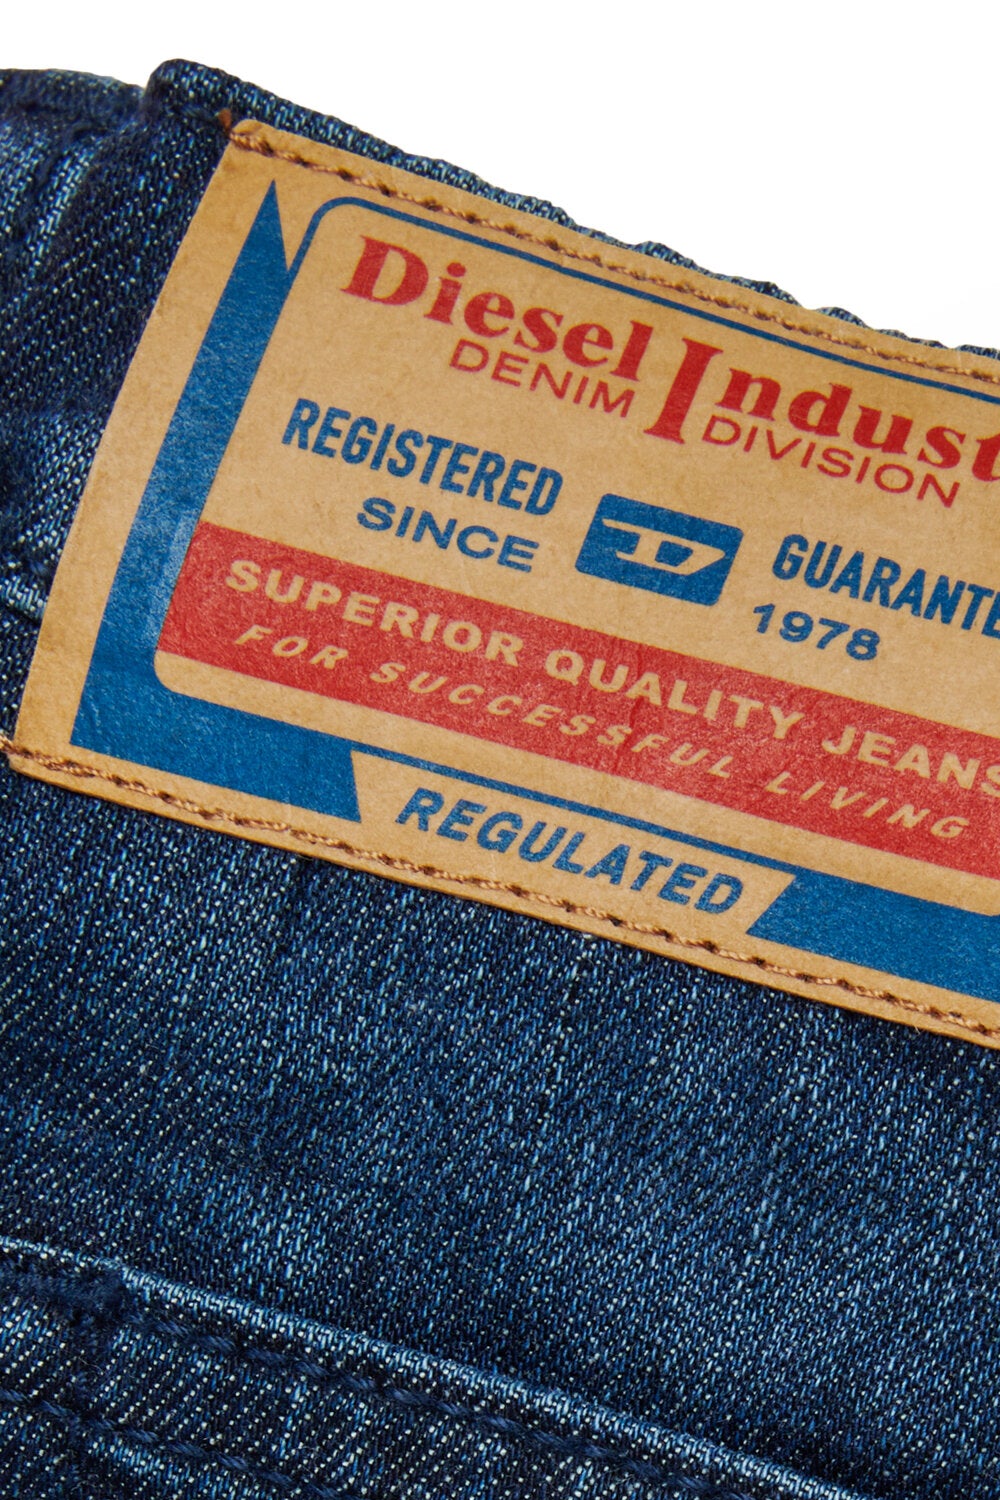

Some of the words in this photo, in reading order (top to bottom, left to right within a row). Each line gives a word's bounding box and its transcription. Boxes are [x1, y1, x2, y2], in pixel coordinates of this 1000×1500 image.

[340, 235, 654, 381] Diesel
[282, 397, 564, 516] REGISTERED
[449, 338, 635, 418] DENIM
[702, 414, 960, 508] DIVISION
[356, 496, 540, 573] SINCE
[224, 559, 525, 667] SUPERIOR
[544, 649, 804, 741] QUALITY
[753, 603, 881, 661] 1978
[234, 623, 349, 670] FOR
[369, 661, 734, 779] SUCCESSFUL
[764, 771, 970, 840] LIVING
[394, 787, 744, 915] REGULATED
